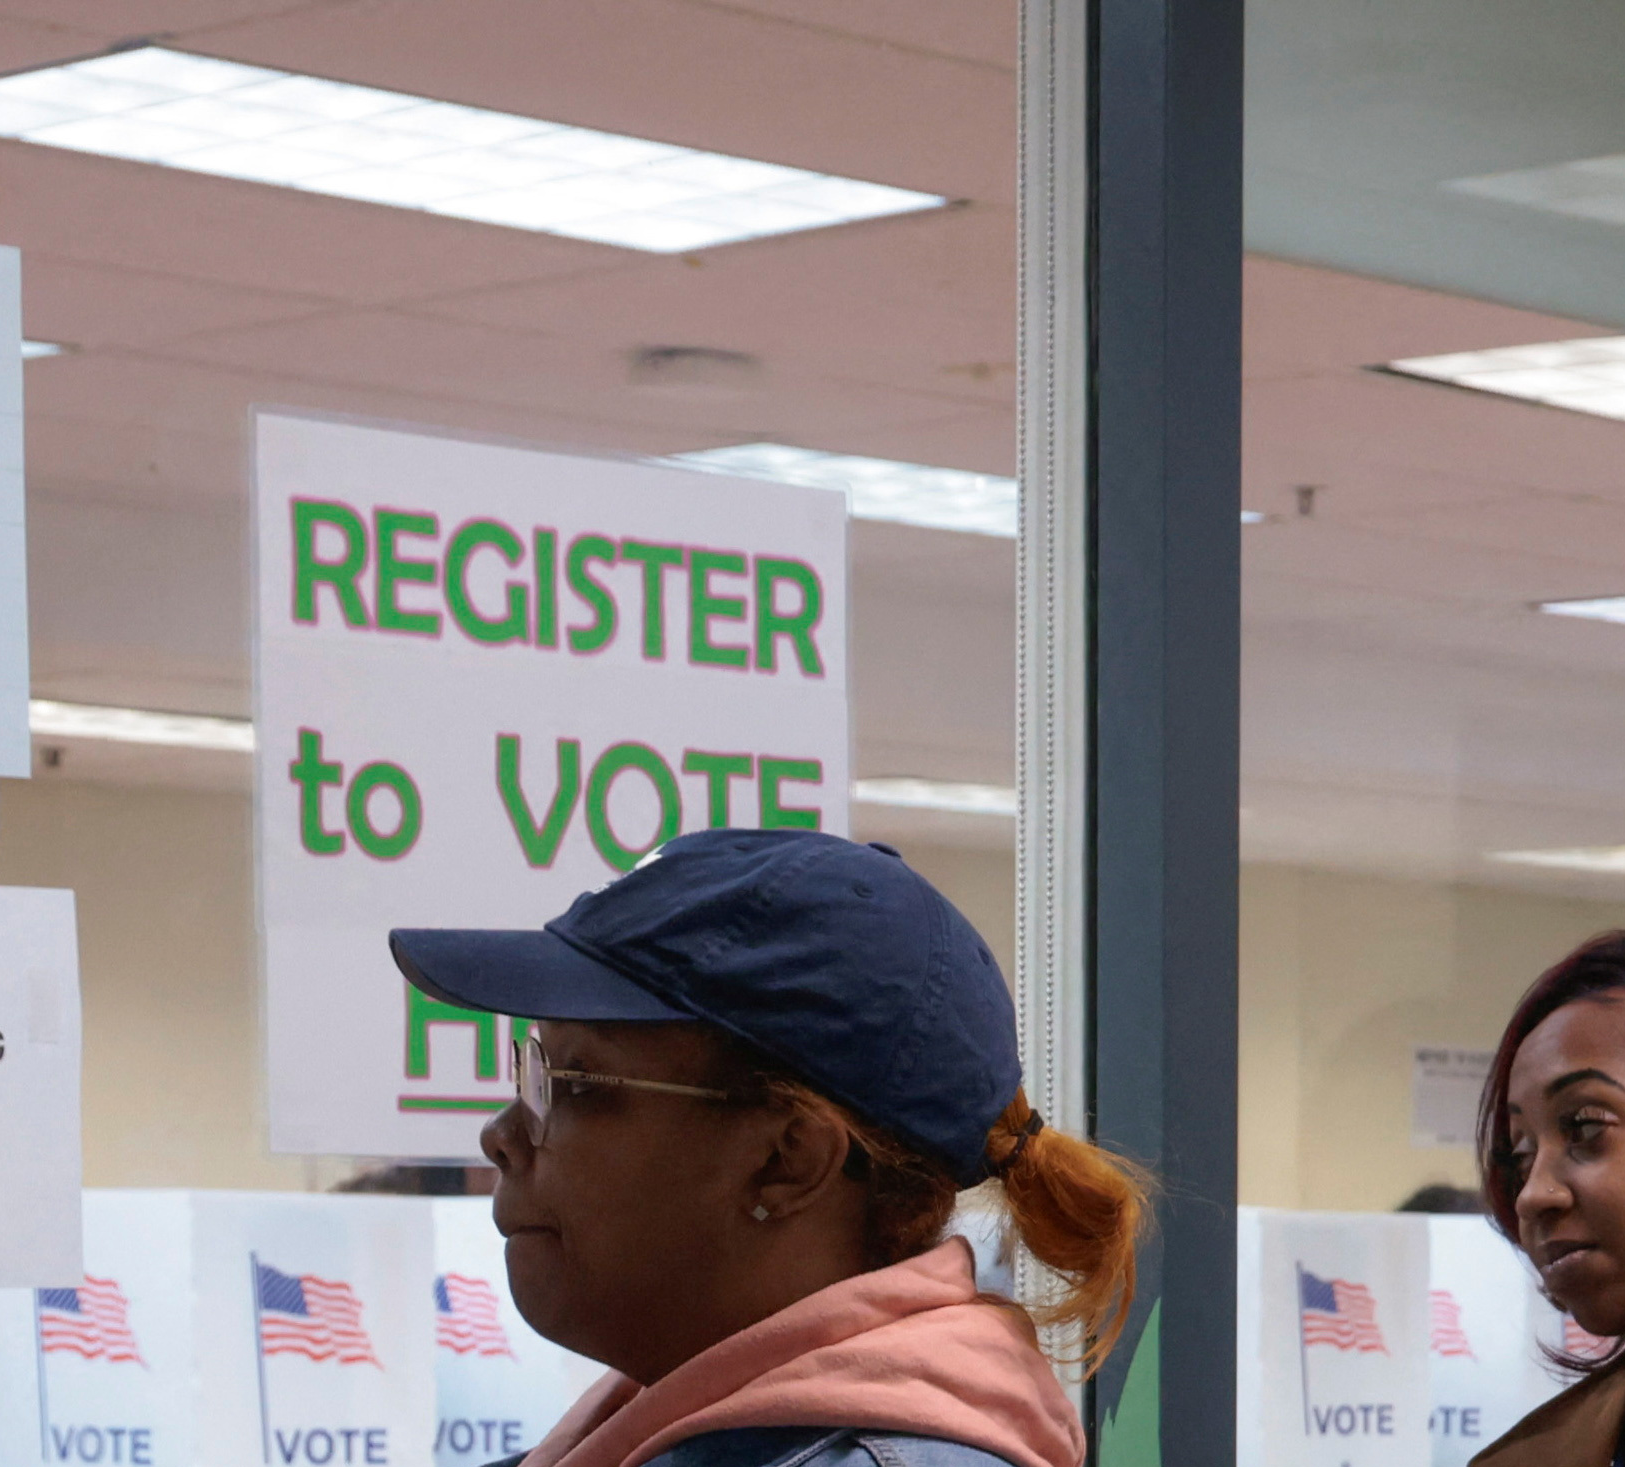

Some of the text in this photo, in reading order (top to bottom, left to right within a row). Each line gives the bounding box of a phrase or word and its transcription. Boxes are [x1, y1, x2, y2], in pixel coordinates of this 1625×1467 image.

[292, 499, 825, 676] REGISTER
[290, 730, 822, 873] to VOTE
[1313, 1404, 1395, 1437] VOTE
[50, 1425, 154, 1466] VOTE
[275, 1427, 389, 1467] VOTE
